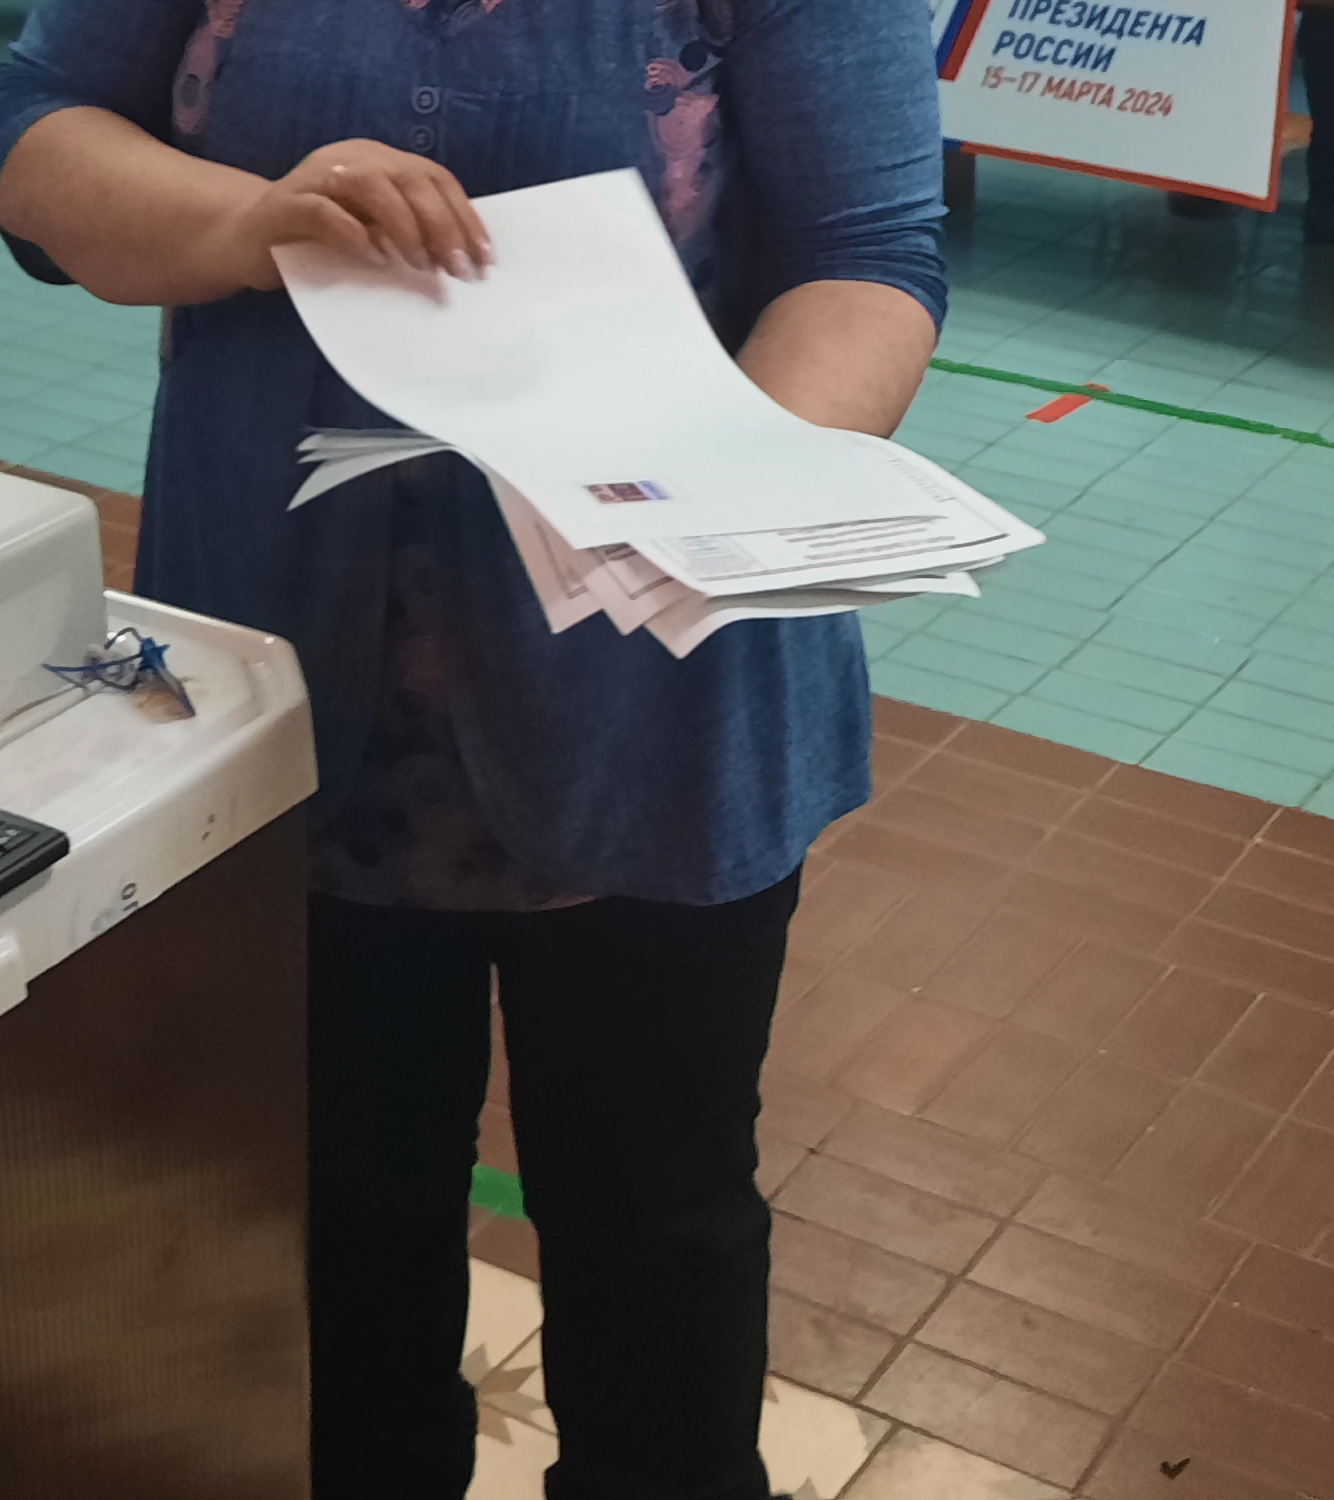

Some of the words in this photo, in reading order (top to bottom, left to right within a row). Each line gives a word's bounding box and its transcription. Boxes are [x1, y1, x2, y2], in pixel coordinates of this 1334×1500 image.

[992, 30, 1116, 73] РОССИИ
[1040, 74, 1115, 108] МАРТА
[1116, 87, 1175, 117] 2024
